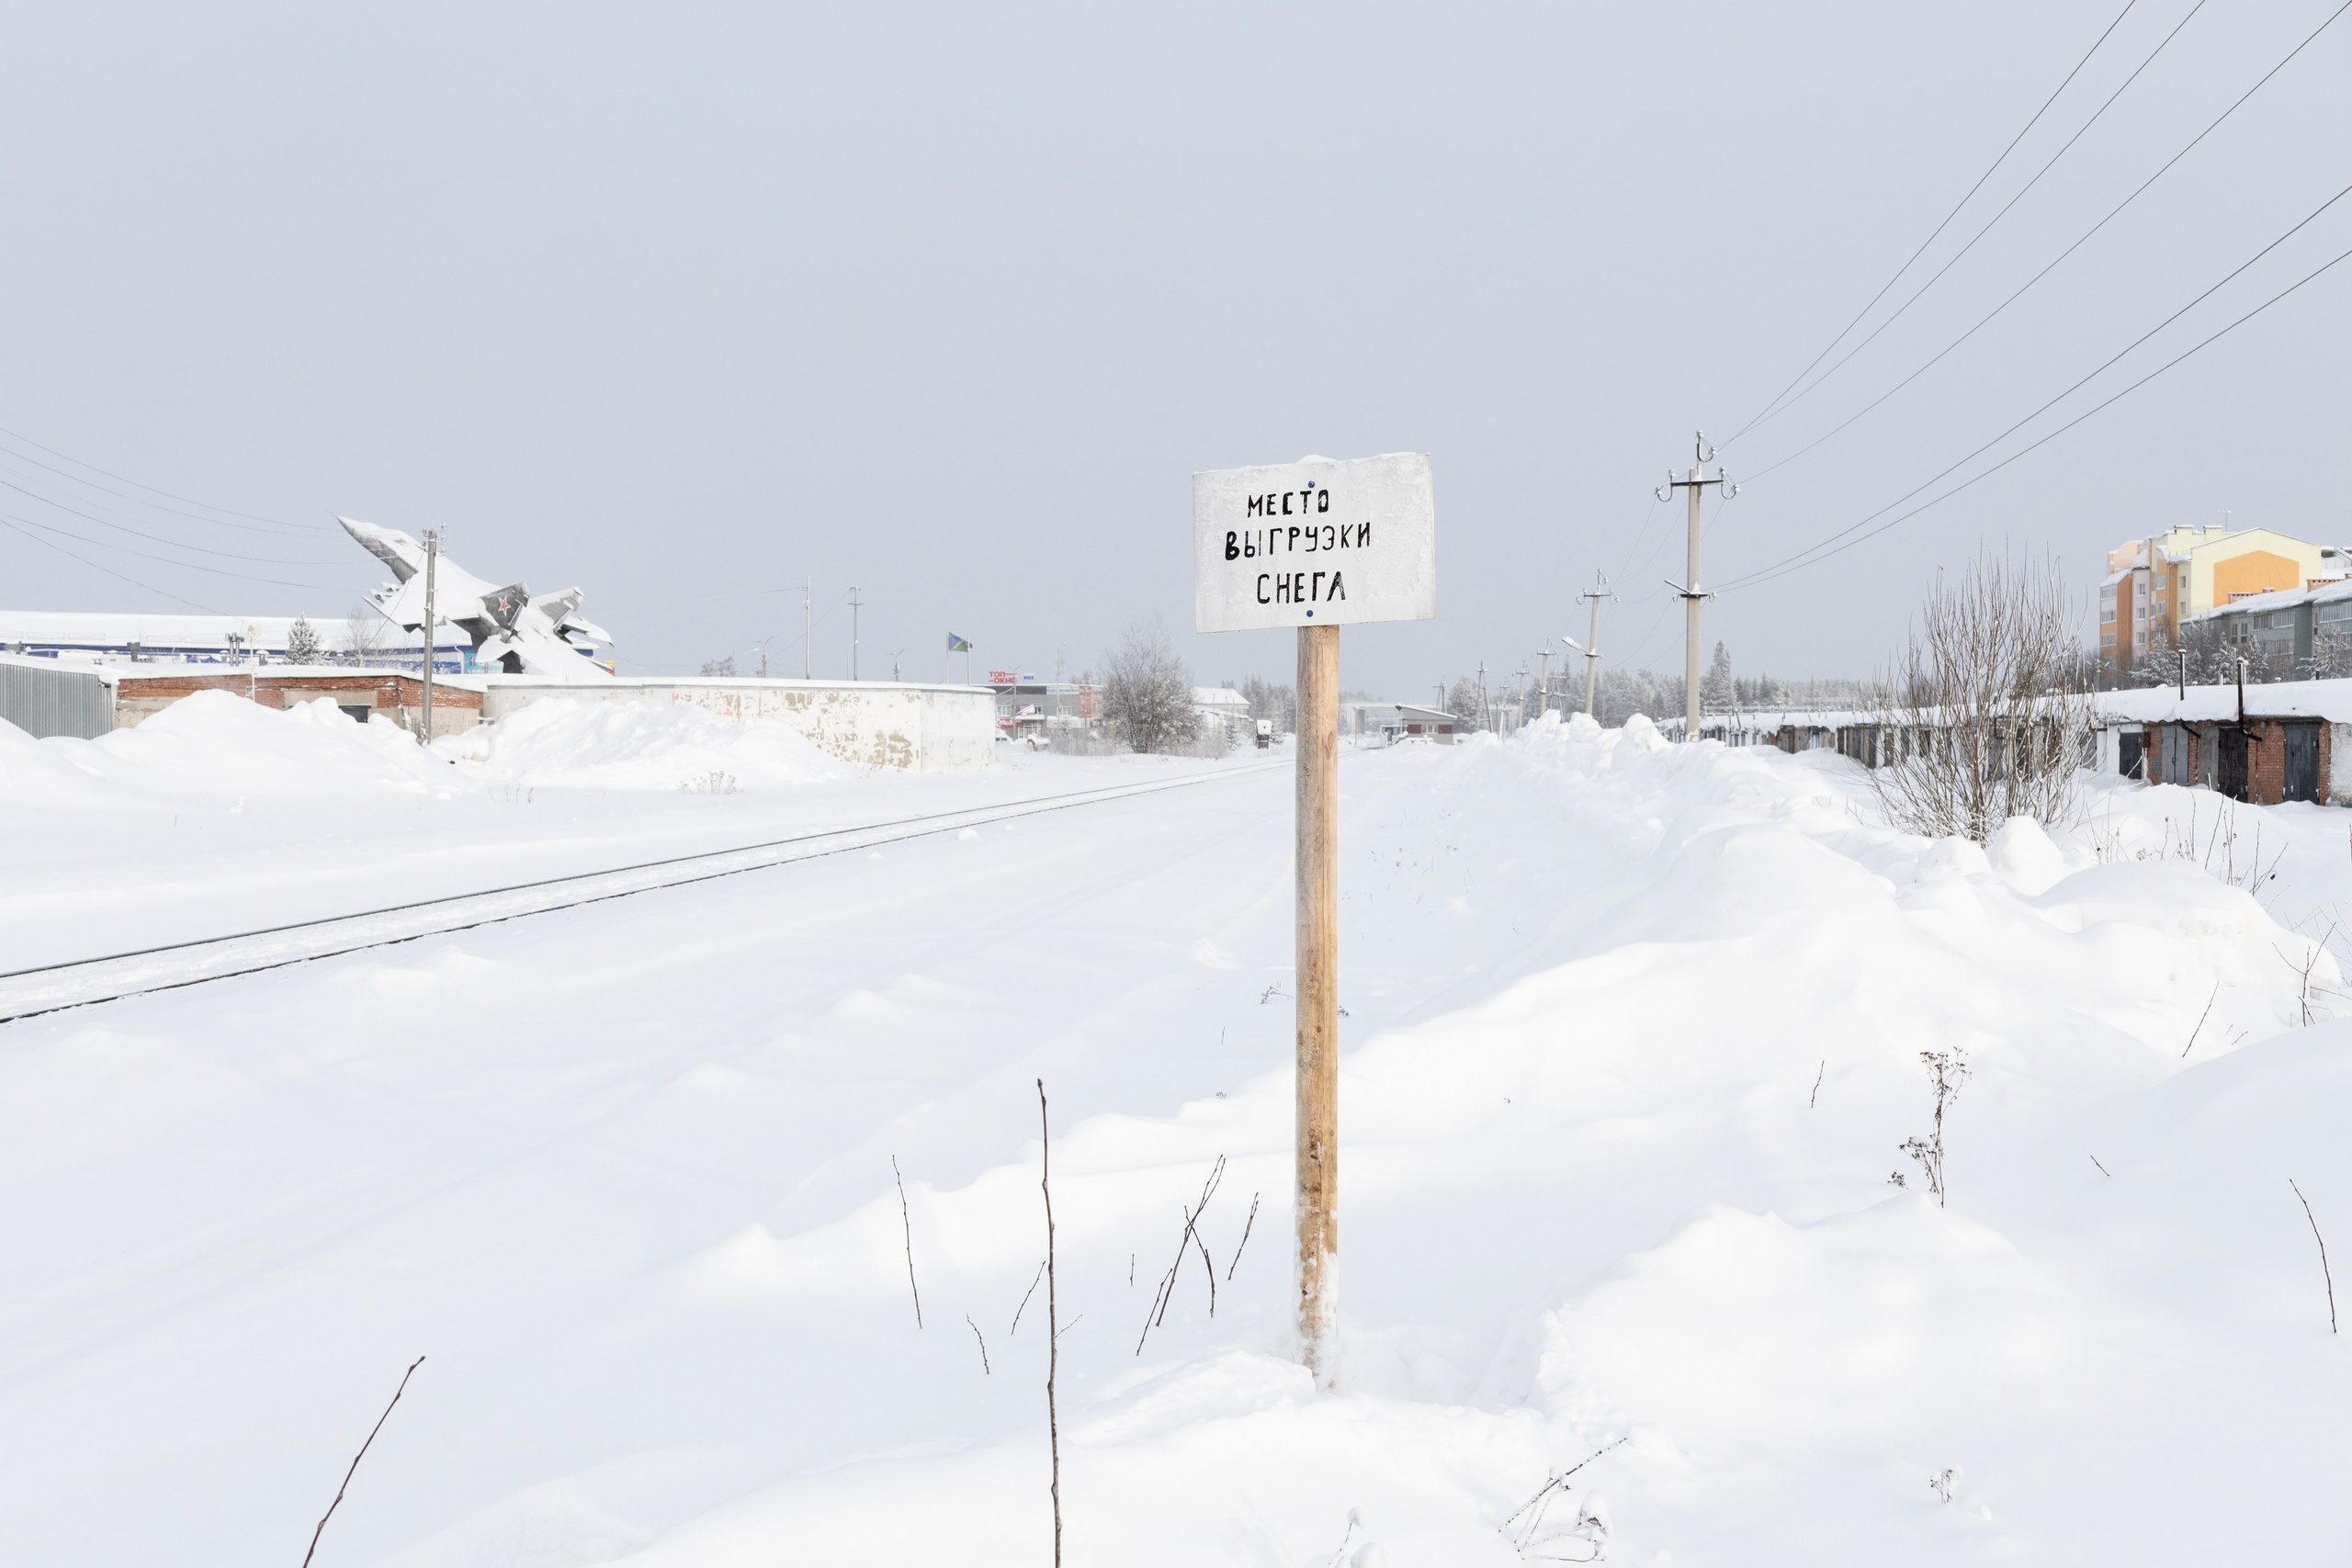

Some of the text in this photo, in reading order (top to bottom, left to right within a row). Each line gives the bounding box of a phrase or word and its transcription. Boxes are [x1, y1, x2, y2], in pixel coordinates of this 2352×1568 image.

[1247, 489, 1330, 518] МЕСТО
[1225, 522, 1371, 561] ВЫГРУЗКИ
[1257, 570, 1347, 604] СНЕГА
